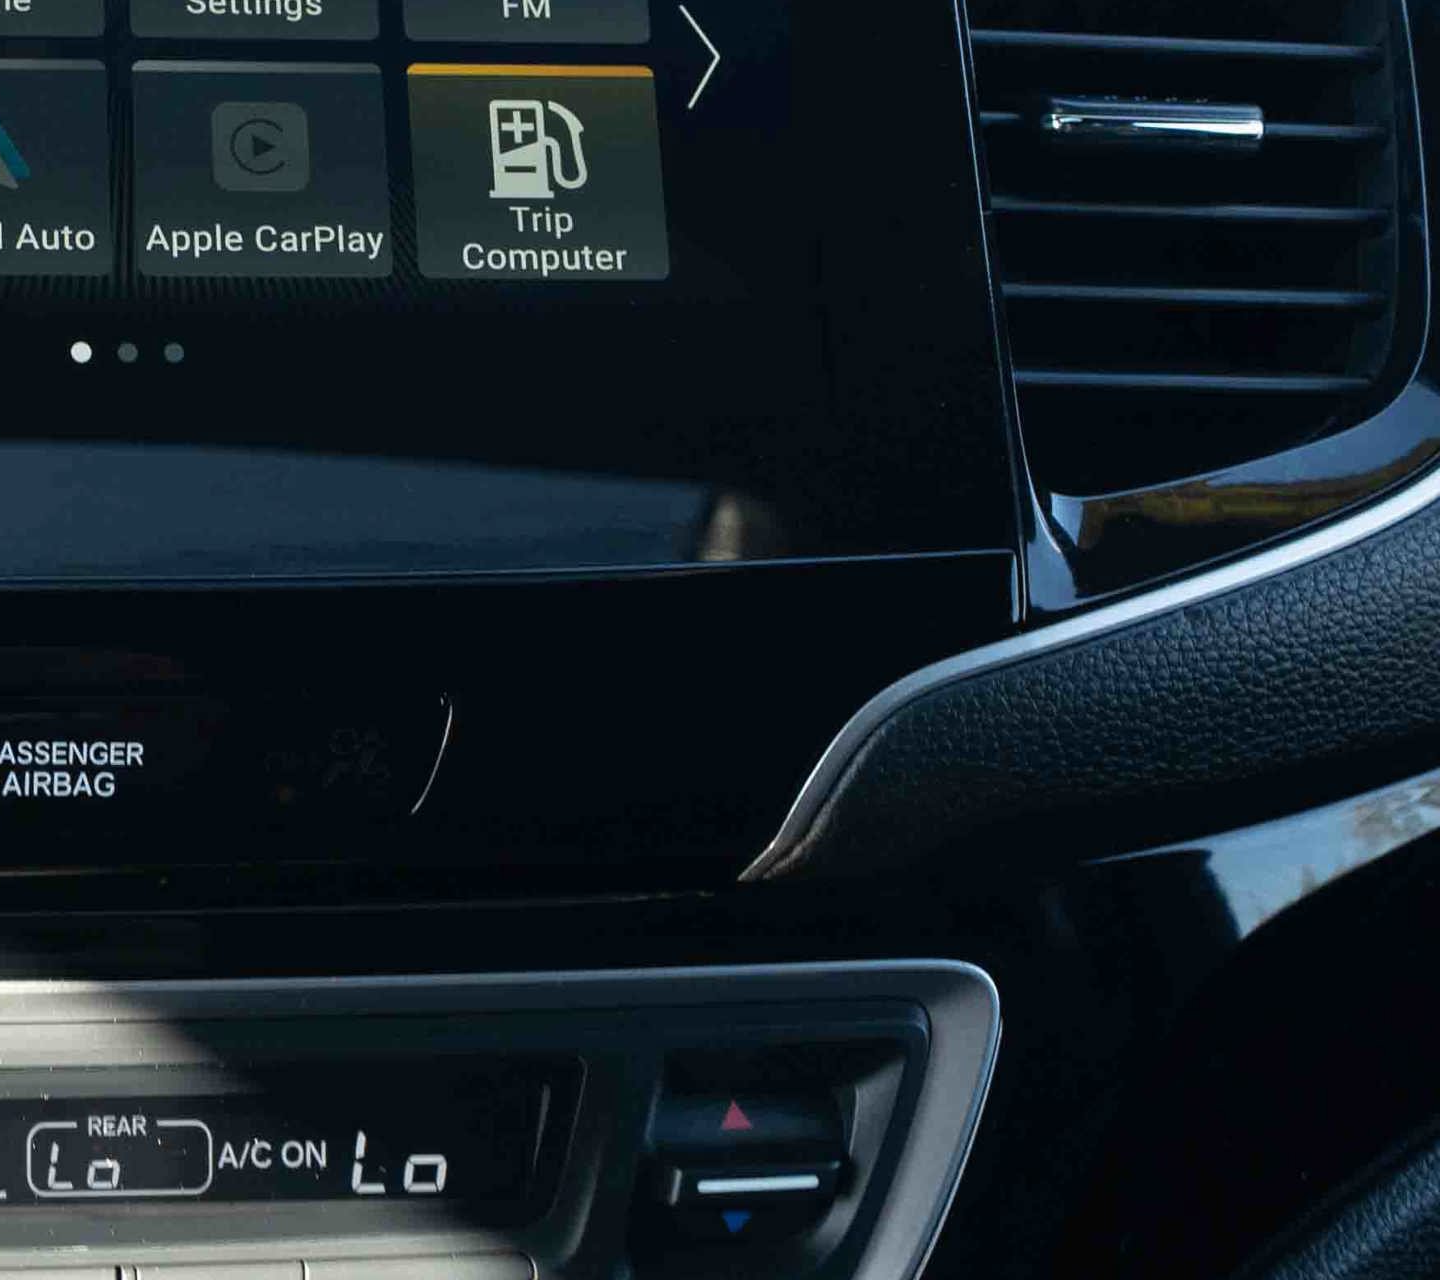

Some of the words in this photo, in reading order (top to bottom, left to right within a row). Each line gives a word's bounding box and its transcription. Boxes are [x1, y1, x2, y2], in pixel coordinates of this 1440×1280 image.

[16, 222, 95, 251] Auto
[510, 204, 574, 239] Trip
[146, 224, 243, 257] Apple
[254, 225, 383, 258] CarPlay
[461, 242, 627, 276] Computer
[1, 770, 115, 799] AIRBAG
[87, 1114, 147, 1137] REAR
[218, 1140, 273, 1171] A/C
[280, 1140, 327, 1169] ON
